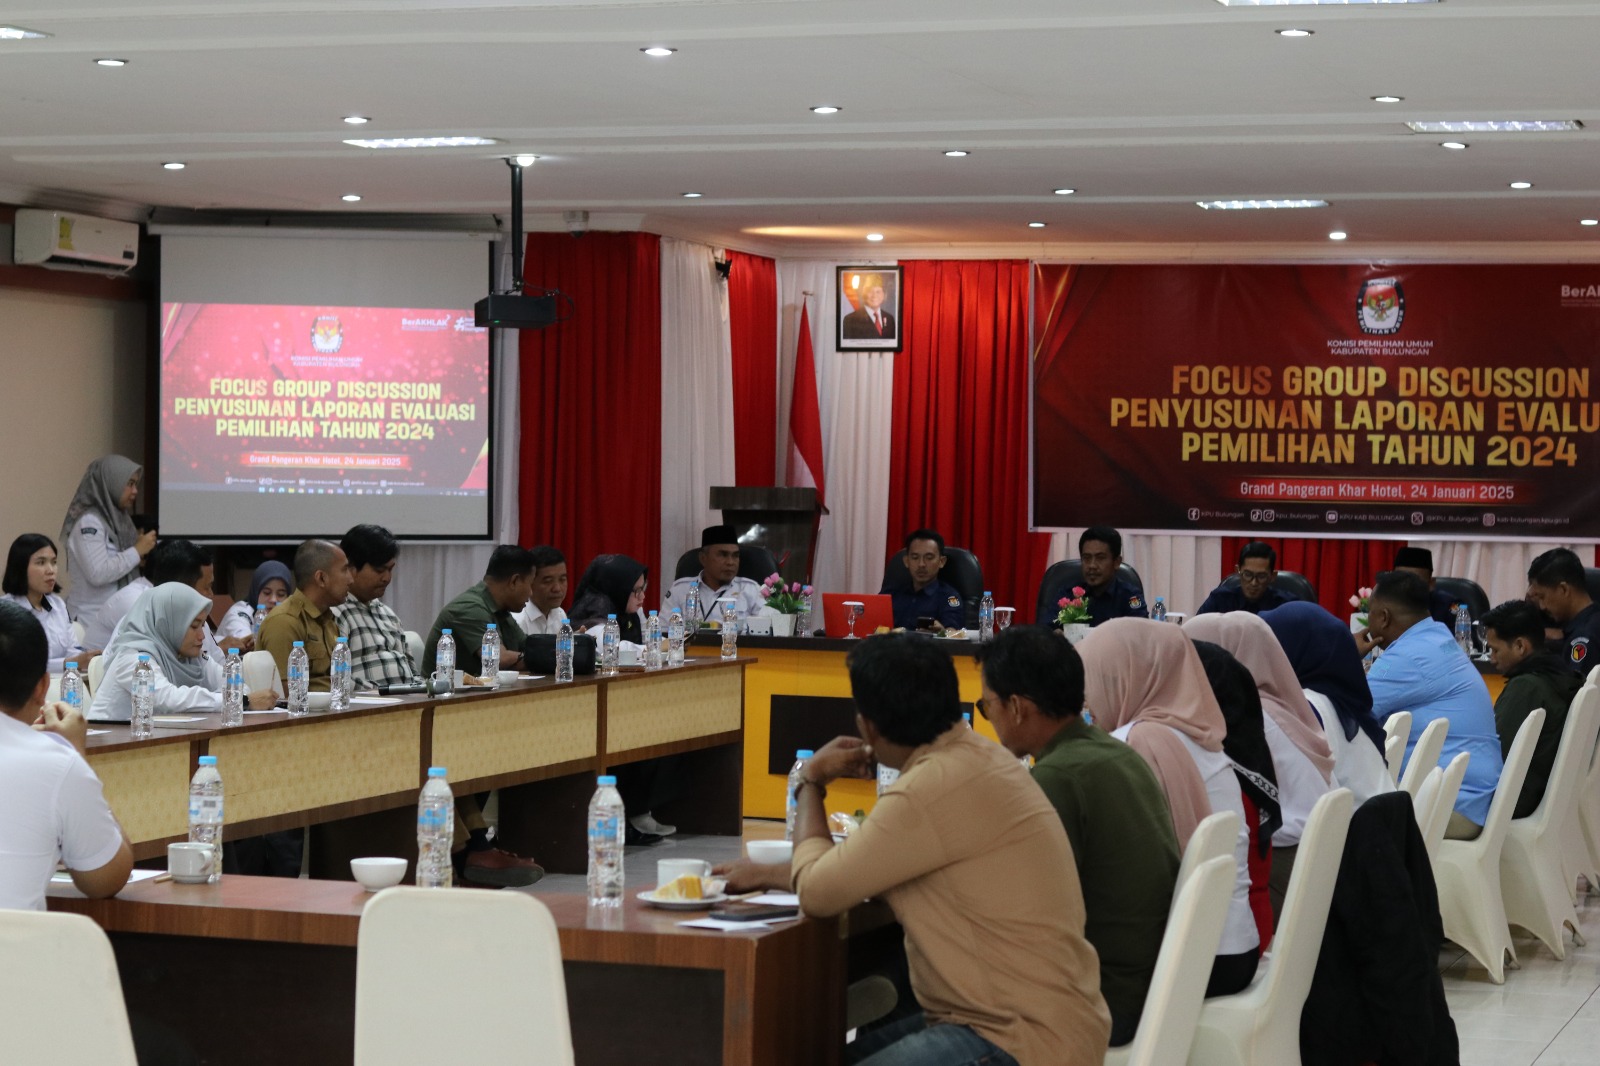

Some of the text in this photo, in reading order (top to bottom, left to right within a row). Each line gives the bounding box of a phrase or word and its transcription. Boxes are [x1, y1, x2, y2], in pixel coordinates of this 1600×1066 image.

[1327, 340, 1434, 348] KOMISI PEMILIHAN UMUM
[210, 378, 441, 400] FOCUS GROUP DISCUSSION
[1172, 365, 1590, 398] FOCUS GROUP DISCUSSION
[175, 397, 475, 421] PENYUSUNAN LAPORAN EVALUASI
[1111, 398, 1600, 433] PENYUSUNAN LAPORAN EVALU
[216, 418, 435, 440] PEMILIHAN TAHUN 2024
[250, 455, 269, 464] Grand
[272, 455, 303, 465] Pangeran
[304, 456, 320, 464] Khar
[344, 457, 354, 465] 24
[356, 457, 380, 465] Januari
[382, 457, 401, 466] 2025
[1182, 432, 1577, 467] PEMILIHAN TAHUN 2024
[1240, 482, 1514, 500] Grand Pangeran Khar Hotel, 24 Januari 2025
[1215, 511, 1244, 519] Bulungan
[1340, 513, 1353, 521] KPU
